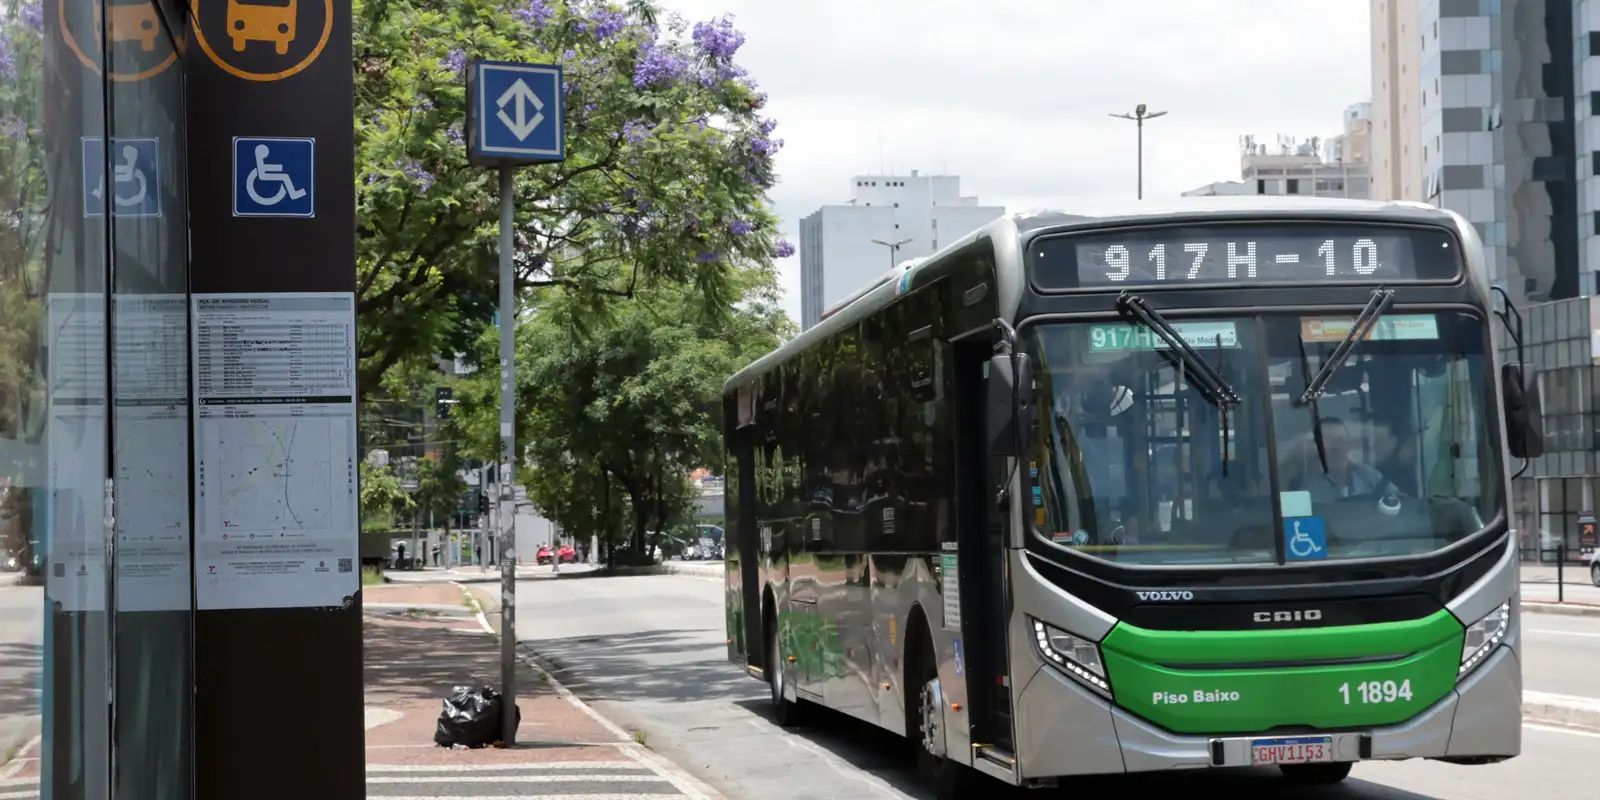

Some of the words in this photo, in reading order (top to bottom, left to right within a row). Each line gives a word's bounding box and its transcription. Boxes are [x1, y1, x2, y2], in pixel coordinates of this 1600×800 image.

[1092, 325, 1150, 348] 917H
[1197, 335, 1234, 344] Madaena
[1136, 590, 1194, 601] VOLVO
[1253, 609, 1322, 622] CAIO
[1152, 692, 1188, 704] Piso
[1193, 689, 1240, 703] Baixo
[1259, 744, 1324, 762] GHV1I53
